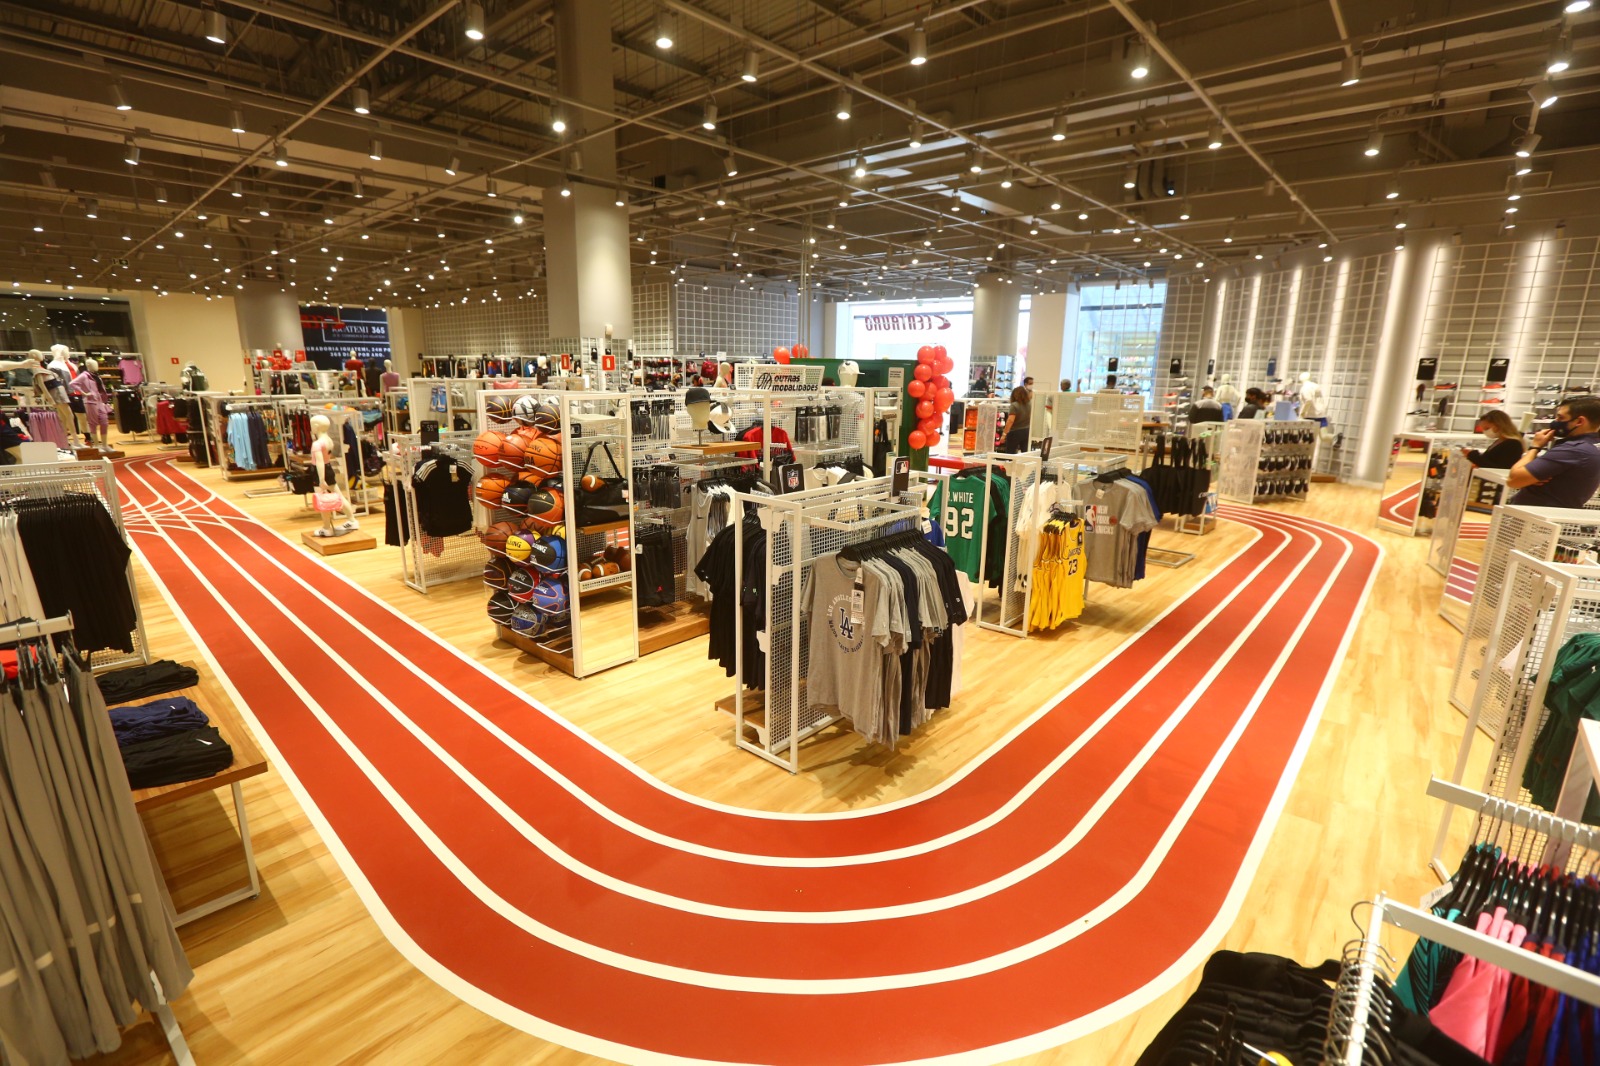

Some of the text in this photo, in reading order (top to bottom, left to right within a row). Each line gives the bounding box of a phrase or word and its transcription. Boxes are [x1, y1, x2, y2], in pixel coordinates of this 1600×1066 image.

[371, 326, 386, 334] 365
[788, 476, 799, 486] NFL
[1097, 505, 1109, 516] NEW
[946, 506, 975, 540] 92
[1068, 558, 1079, 576] 23
[840, 607, 854, 639] LA
